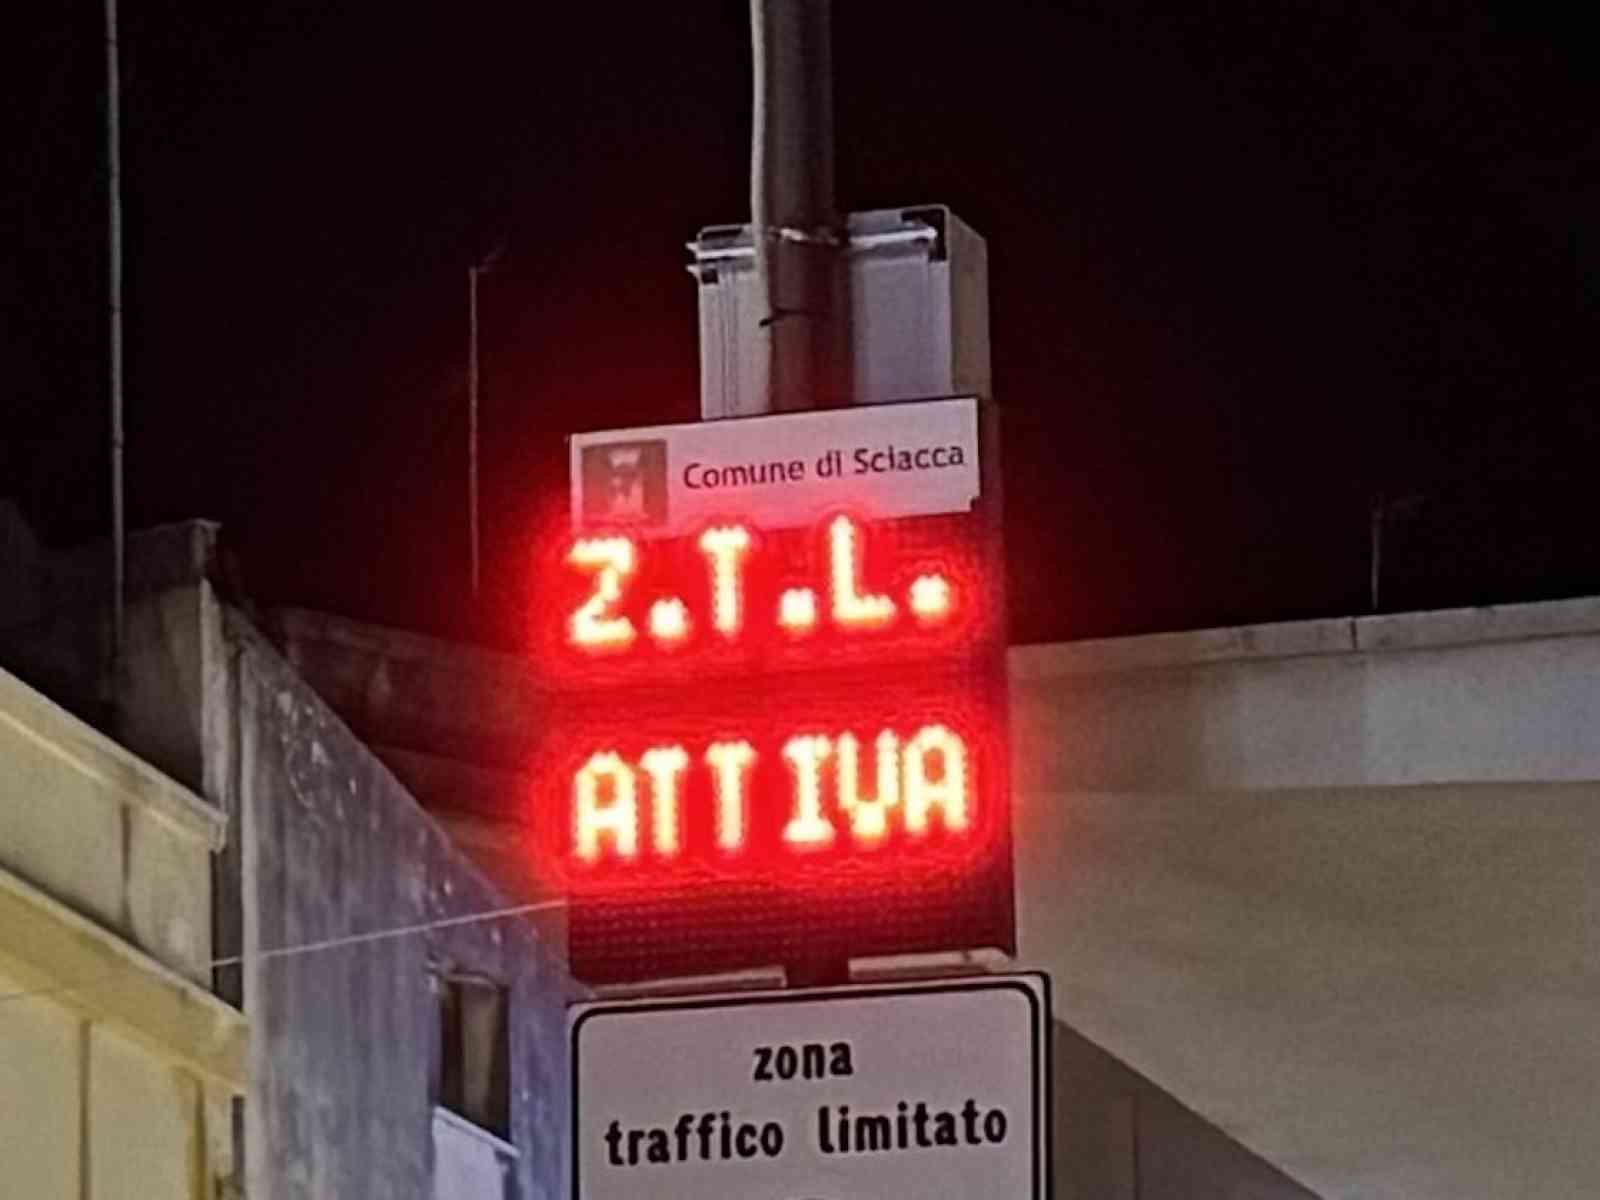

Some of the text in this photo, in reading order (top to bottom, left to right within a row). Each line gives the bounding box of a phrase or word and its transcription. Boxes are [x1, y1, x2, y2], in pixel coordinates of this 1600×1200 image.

[683, 443, 965, 490] Comune di Sciacca
[568, 515, 951, 646] Z.T.L.
[573, 724, 970, 862] ATTIVA
[754, 1041, 854, 1081] zona
[605, 1099, 1007, 1166] traffico limitato
